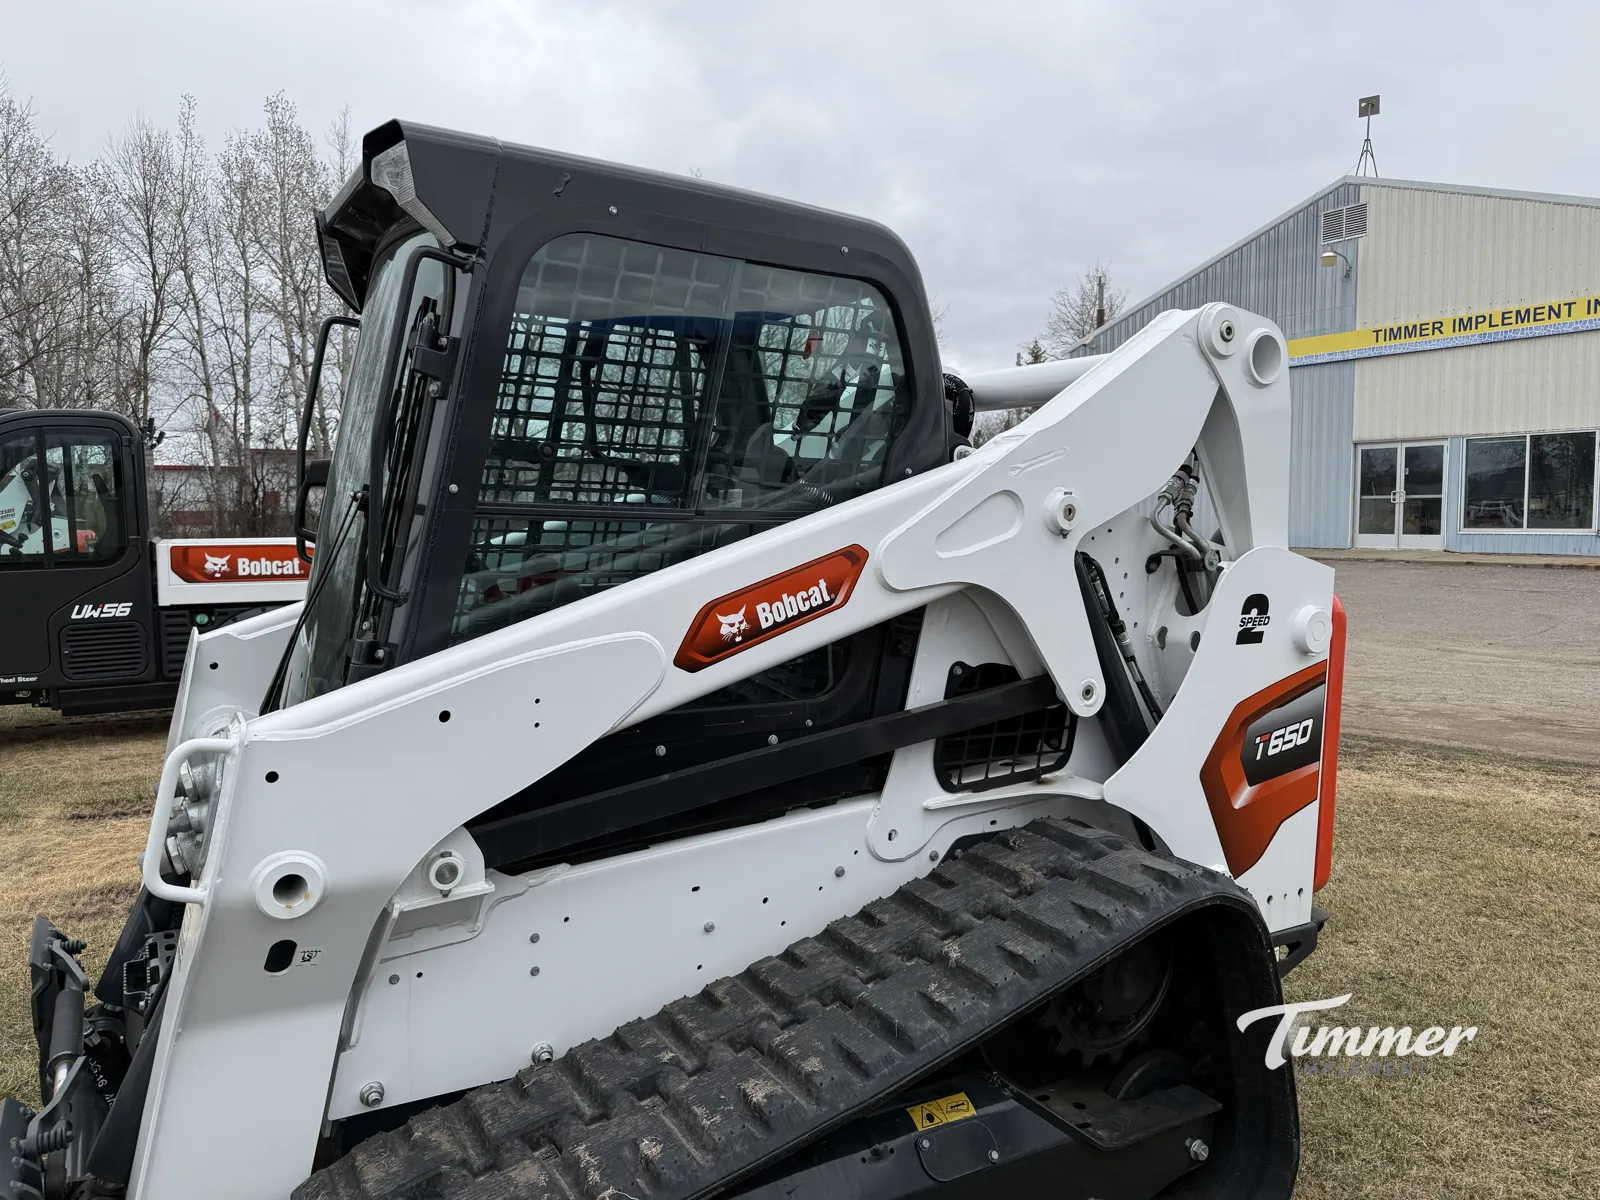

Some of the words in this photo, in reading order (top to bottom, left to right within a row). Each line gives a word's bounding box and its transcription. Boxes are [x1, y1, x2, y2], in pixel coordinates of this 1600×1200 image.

[1372, 320, 1444, 344] TIMMER
[1452, 301, 1577, 334] IMPLEMENT
[237, 557, 301, 576] Bobcat
[70, 602, 133, 620] UW56
[755, 578, 831, 630] Bobcat
[1235, 593, 1270, 646] 2
[1238, 615, 1271, 628] SPEED
[0, 676, 16, 684] heel
[1254, 717, 1315, 761] T650
